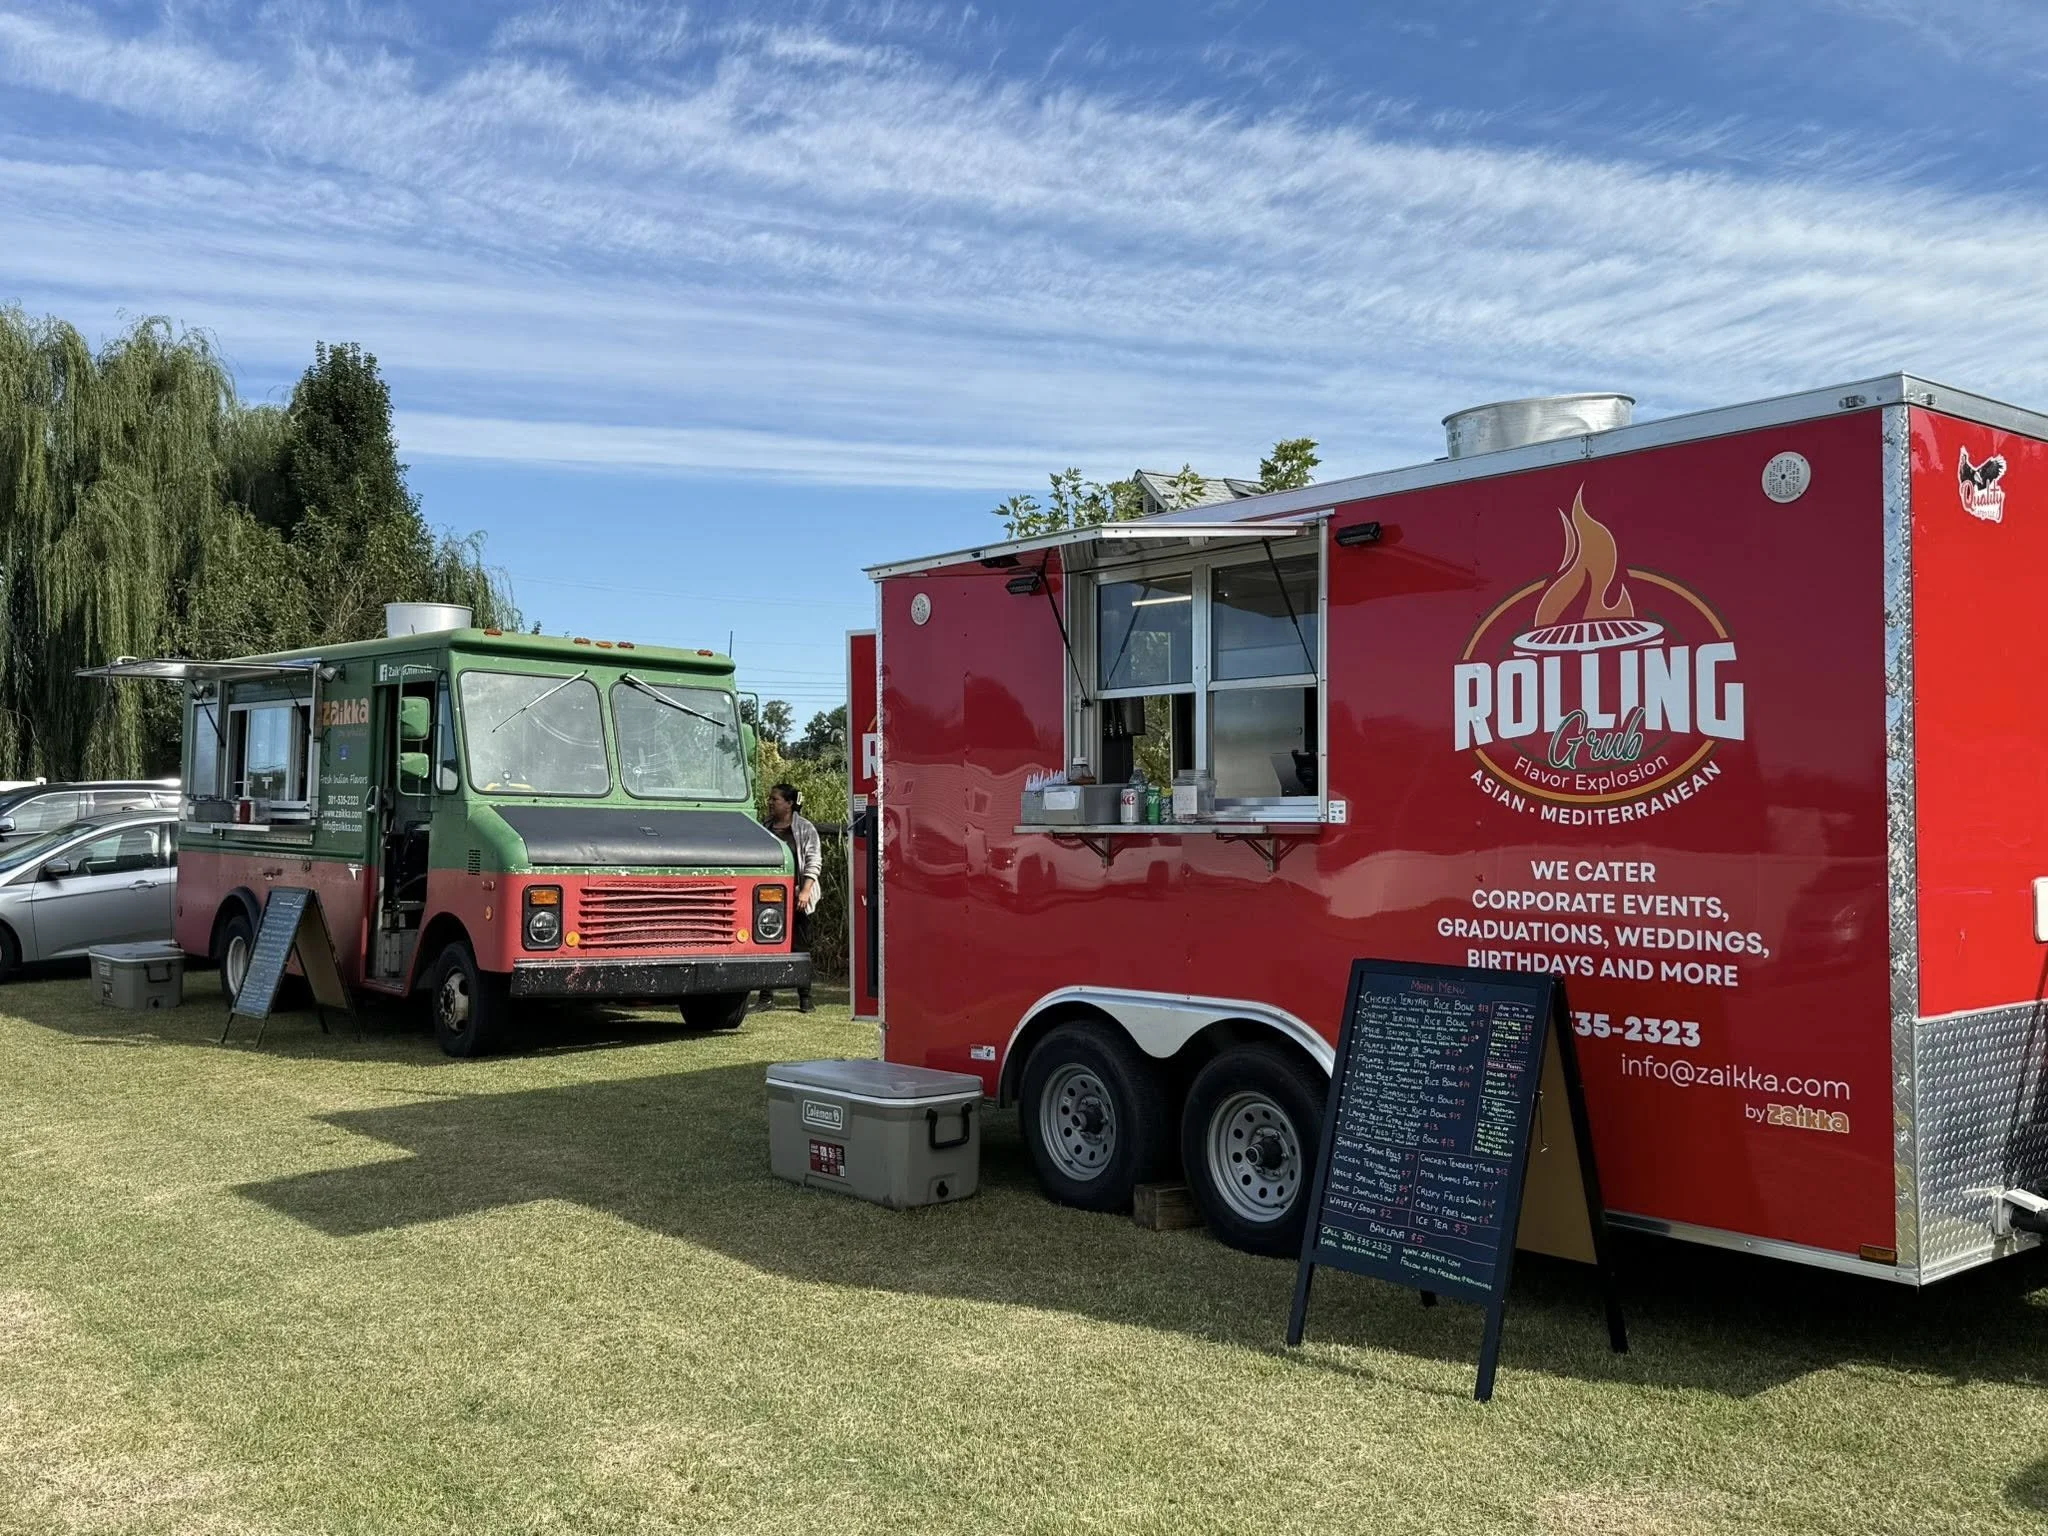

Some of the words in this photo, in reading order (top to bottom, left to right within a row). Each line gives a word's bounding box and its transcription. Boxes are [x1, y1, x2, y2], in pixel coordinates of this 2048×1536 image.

[1961, 479, 2002, 520] Quality
[322, 698, 369, 725] zaikka
[1454, 642, 1744, 751] ROLLING
[1548, 706, 1645, 769] Grub
[1514, 755, 1570, 790] Flavor
[1575, 753, 1668, 794] Explosion
[1469, 769, 1526, 813] ASIAN
[1540, 760, 1722, 825] MEDITERRANEAN
[1531, 860, 1570, 881] WE
[1575, 861, 1656, 883] CATER
[1472, 889, 1616, 914] CORPORATE
[1623, 895, 1730, 922] EVENTS,
[1437, 918, 1610, 949] GRADUATIONS,
[1614, 926, 1770, 958] WEDDINGS,
[1467, 949, 1594, 977] BIRTHDAYS
[1600, 958, 1654, 981] AND
[1661, 961, 1739, 987] MORE
[1621, 1053, 1850, 1100] info@zaikka.com
[806, 1104, 833, 1120] Coleman
[1745, 1104, 1765, 1123] by
[1766, 1103, 1850, 1133] zaikka
[1321, 1226, 1339, 1237] CALL
[1369, 1222, 1405, 1240] BAKLAVA
[1411, 1233, 1425, 1244] $5
[1415, 1215, 1429, 1226] ICE
[1433, 1218, 1448, 1230] TEA
[1454, 1223, 1468, 1235] $3
